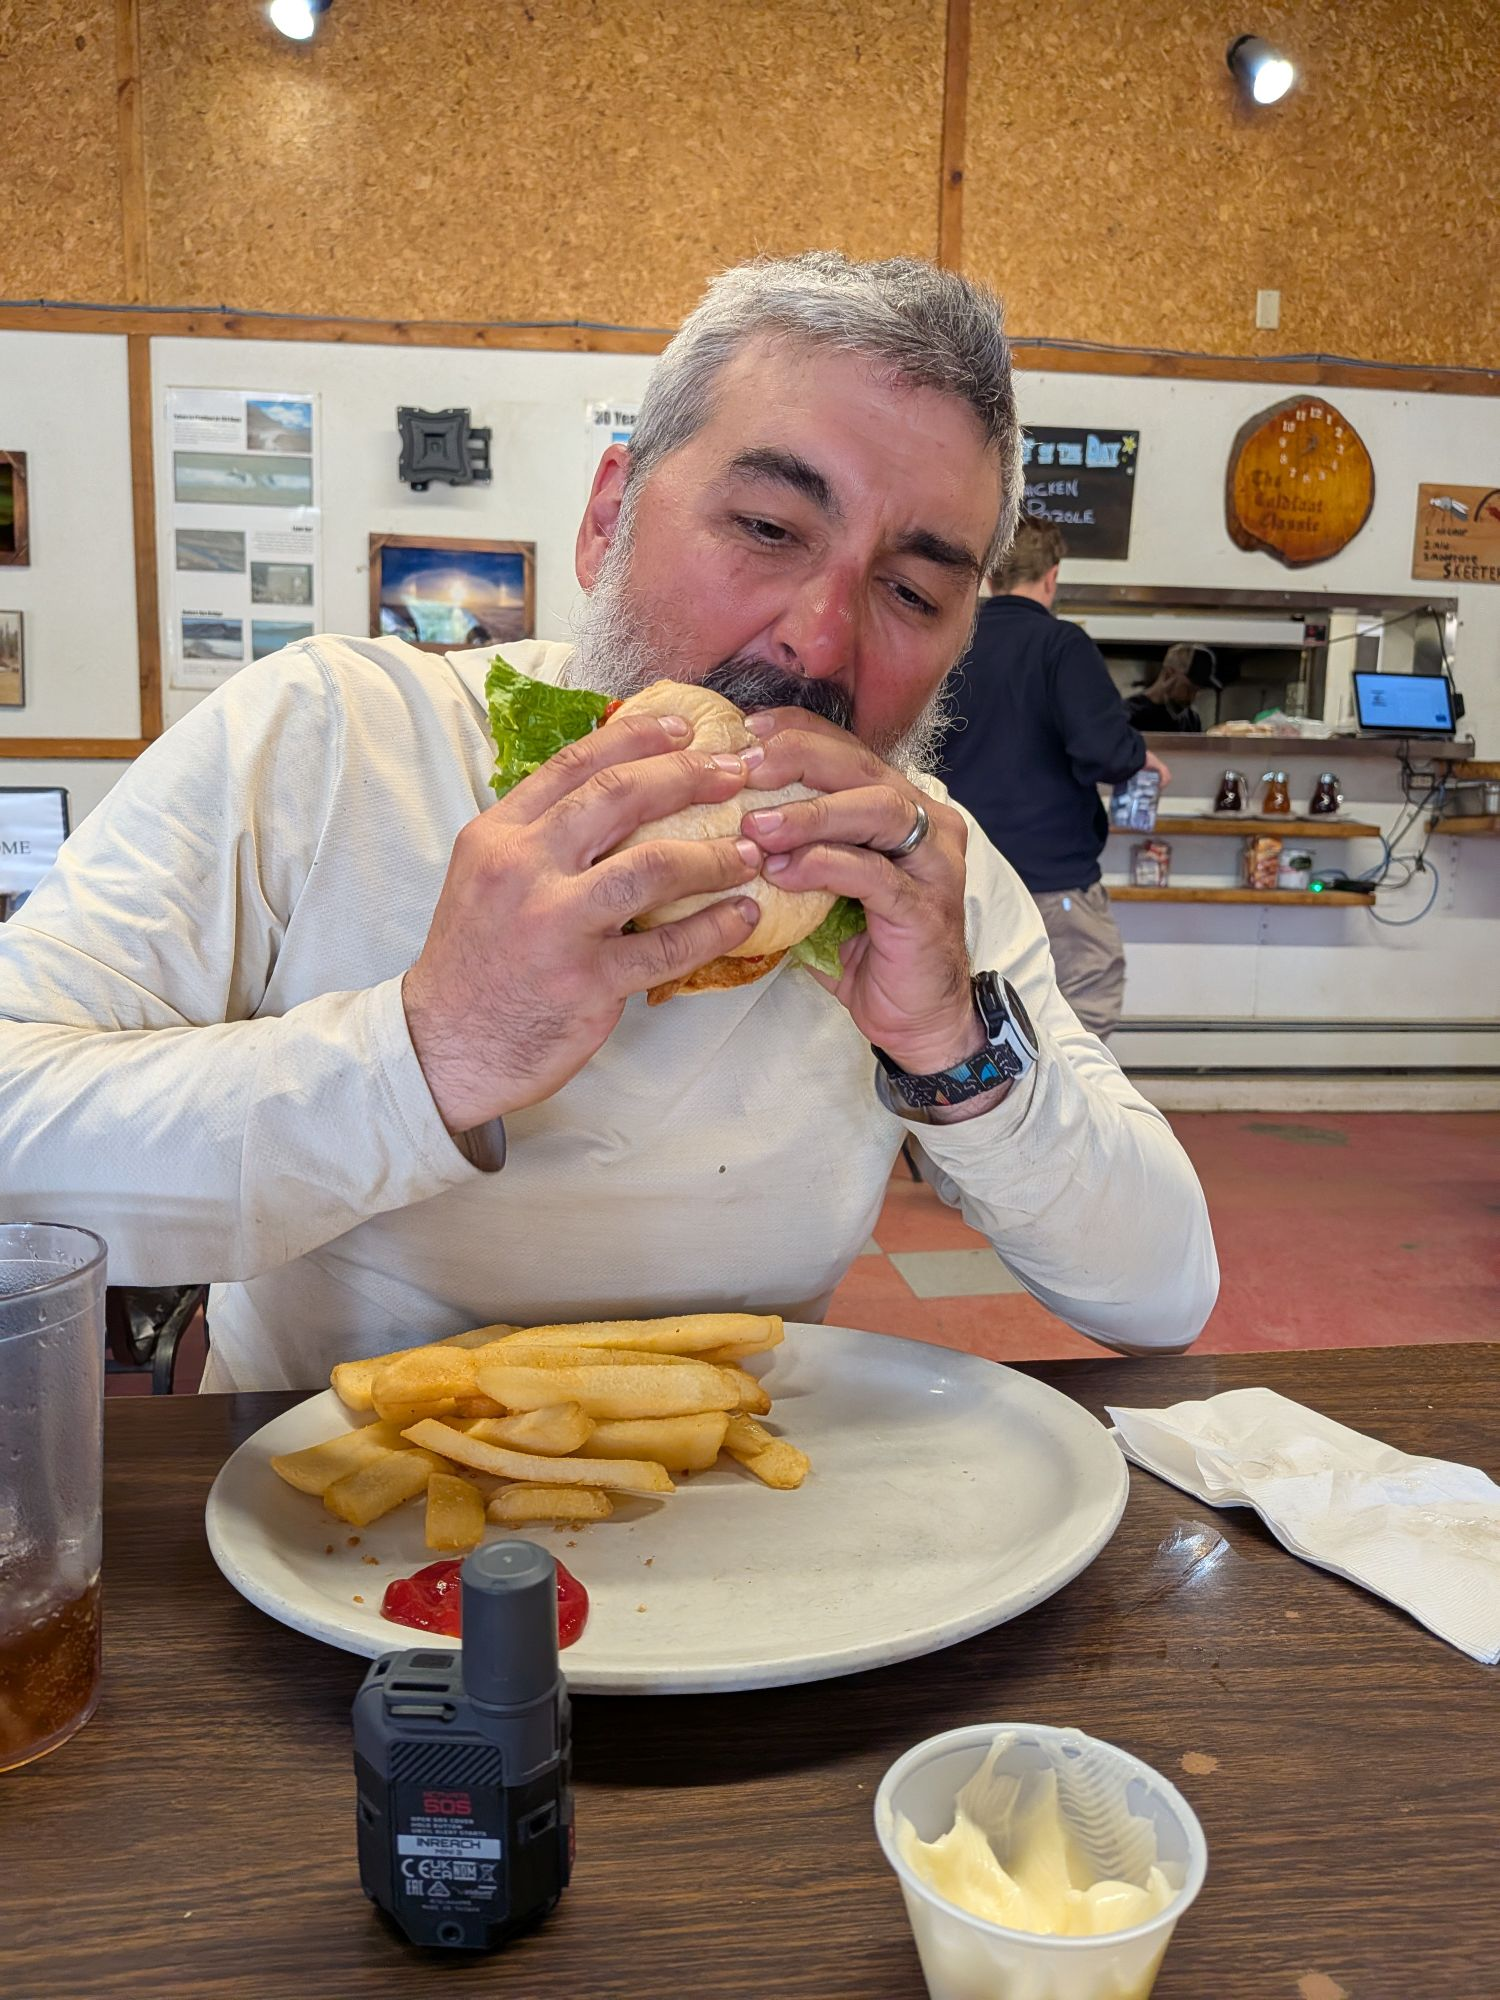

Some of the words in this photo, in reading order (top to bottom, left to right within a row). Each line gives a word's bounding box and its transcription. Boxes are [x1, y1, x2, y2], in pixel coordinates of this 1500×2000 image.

[614, 411, 638, 425] Yea
[1022, 479, 1079, 498] HICKEN
[0, 840, 32, 855] ME
[424, 1799, 472, 1815] SOS
[416, 1837, 482, 1850] INREACH
